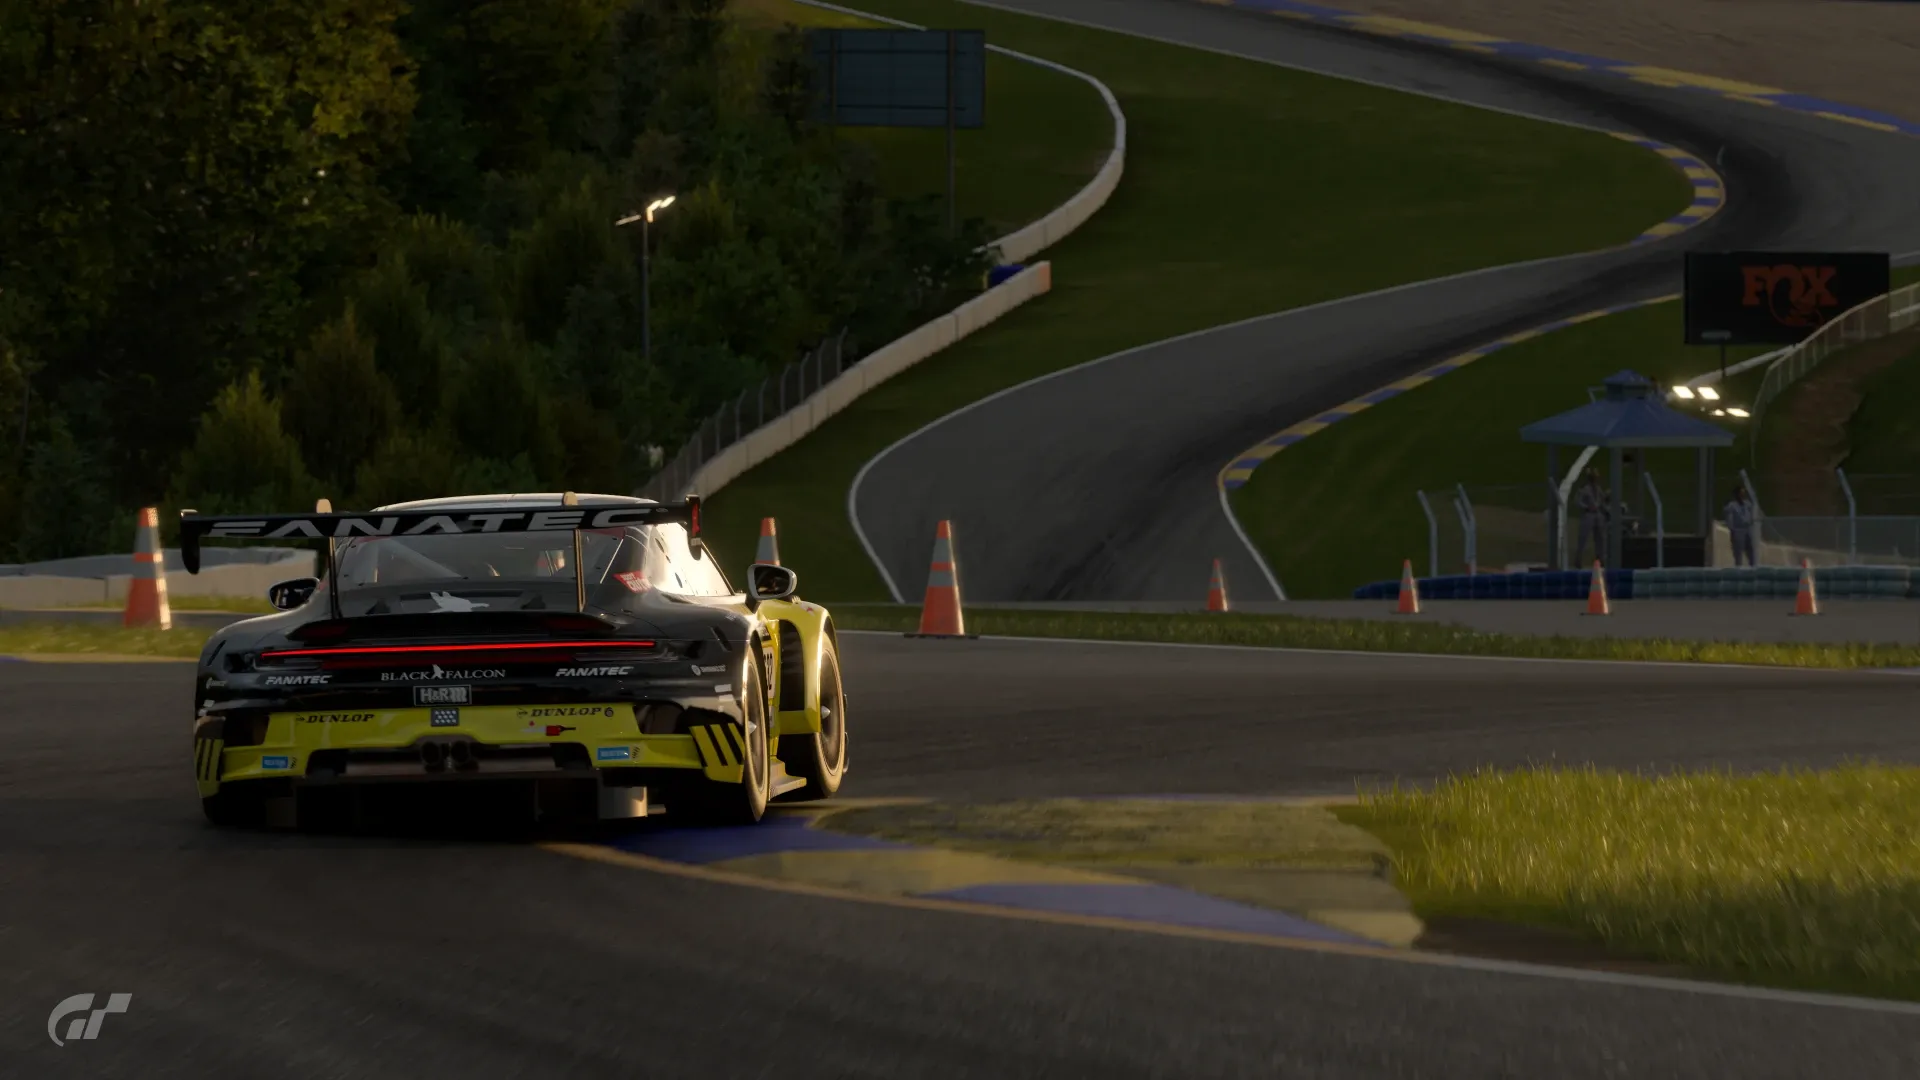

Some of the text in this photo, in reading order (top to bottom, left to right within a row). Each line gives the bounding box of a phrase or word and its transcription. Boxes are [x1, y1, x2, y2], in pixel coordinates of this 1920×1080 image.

[1741, 264, 1838, 327] FOX
[208, 508, 653, 537] FANATEC
[380, 668, 507, 681] BLACK FALCON
[555, 666, 634, 677] FANATEC
[264, 674, 332, 685] FANATEC
[531, 707, 601, 717] DUNLOP
[306, 713, 374, 724] DUNLOP
